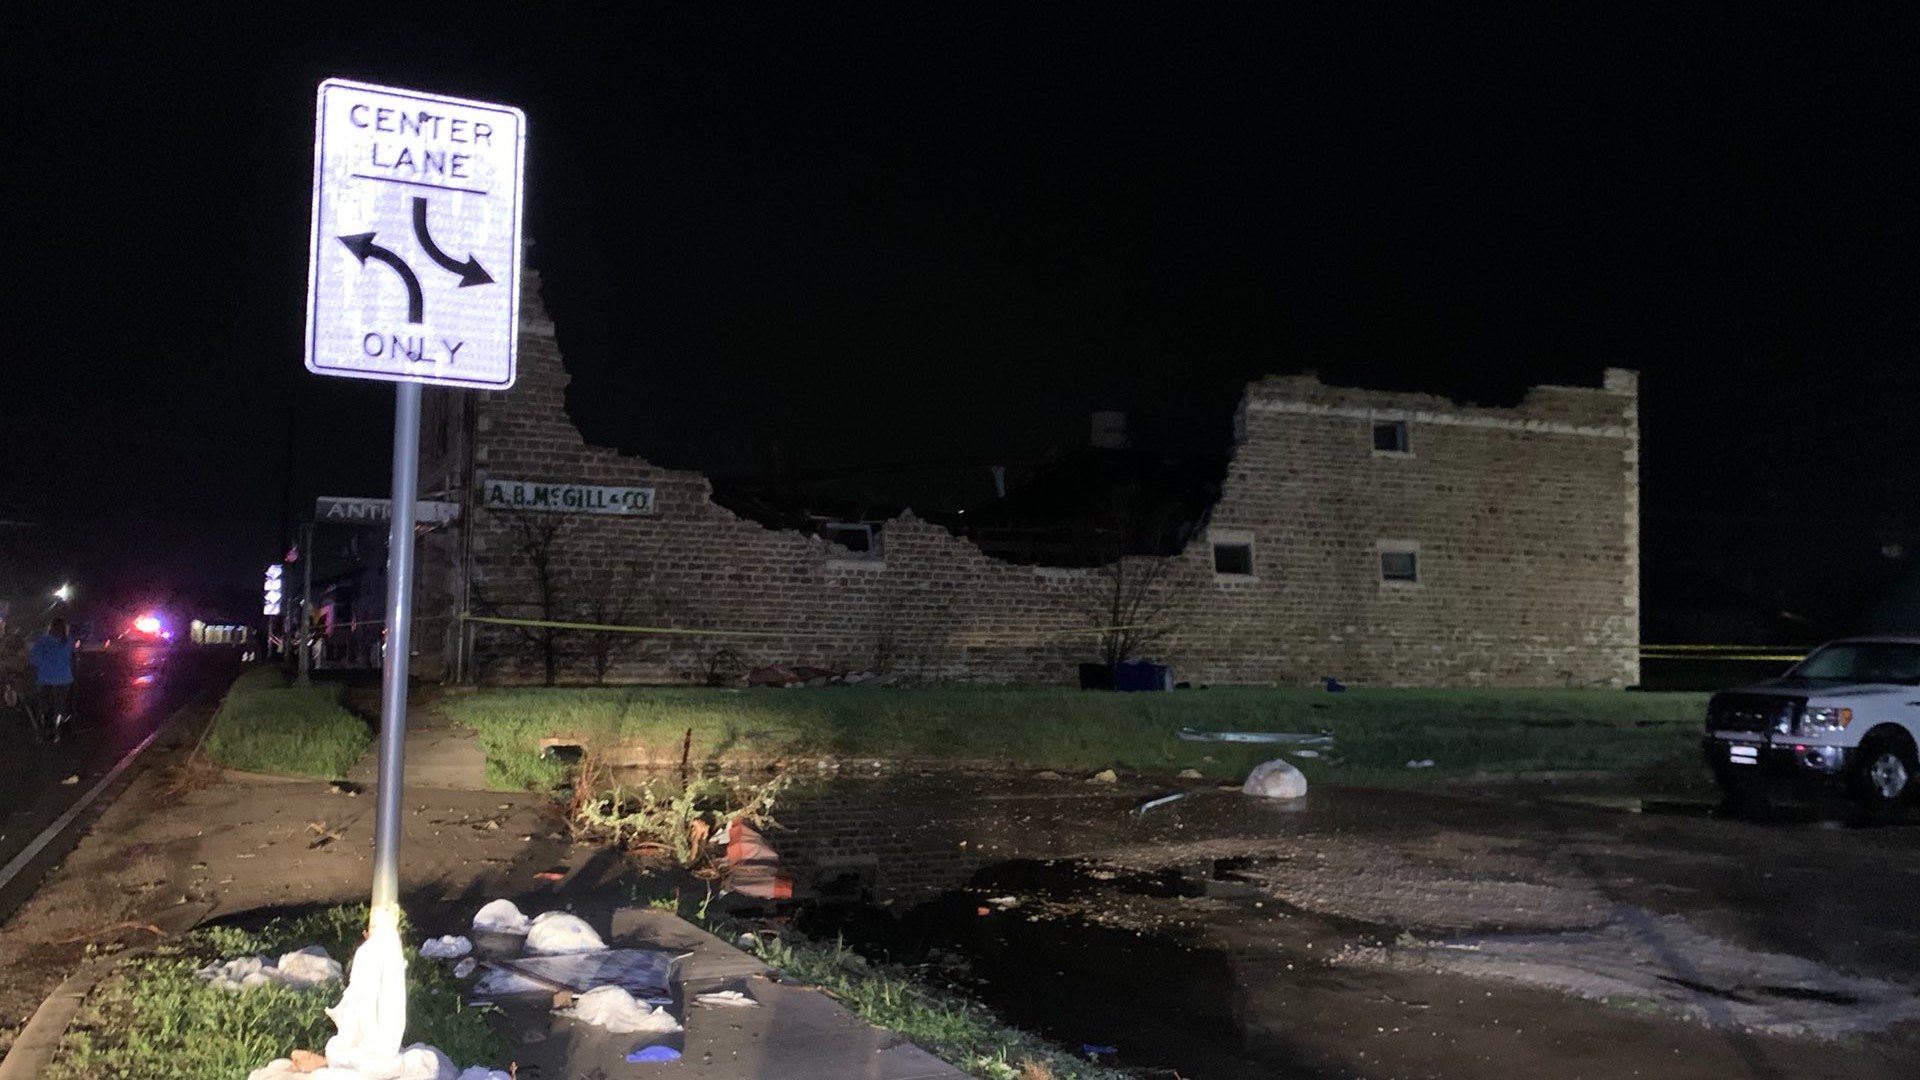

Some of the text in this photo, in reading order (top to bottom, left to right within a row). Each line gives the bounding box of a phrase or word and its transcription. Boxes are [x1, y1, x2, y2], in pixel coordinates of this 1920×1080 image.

[350, 104, 493, 147] CENTER
[371, 142, 473, 178] LANE
[363, 332, 464, 364] ONLY
[326, 502, 392, 520] ANTI
